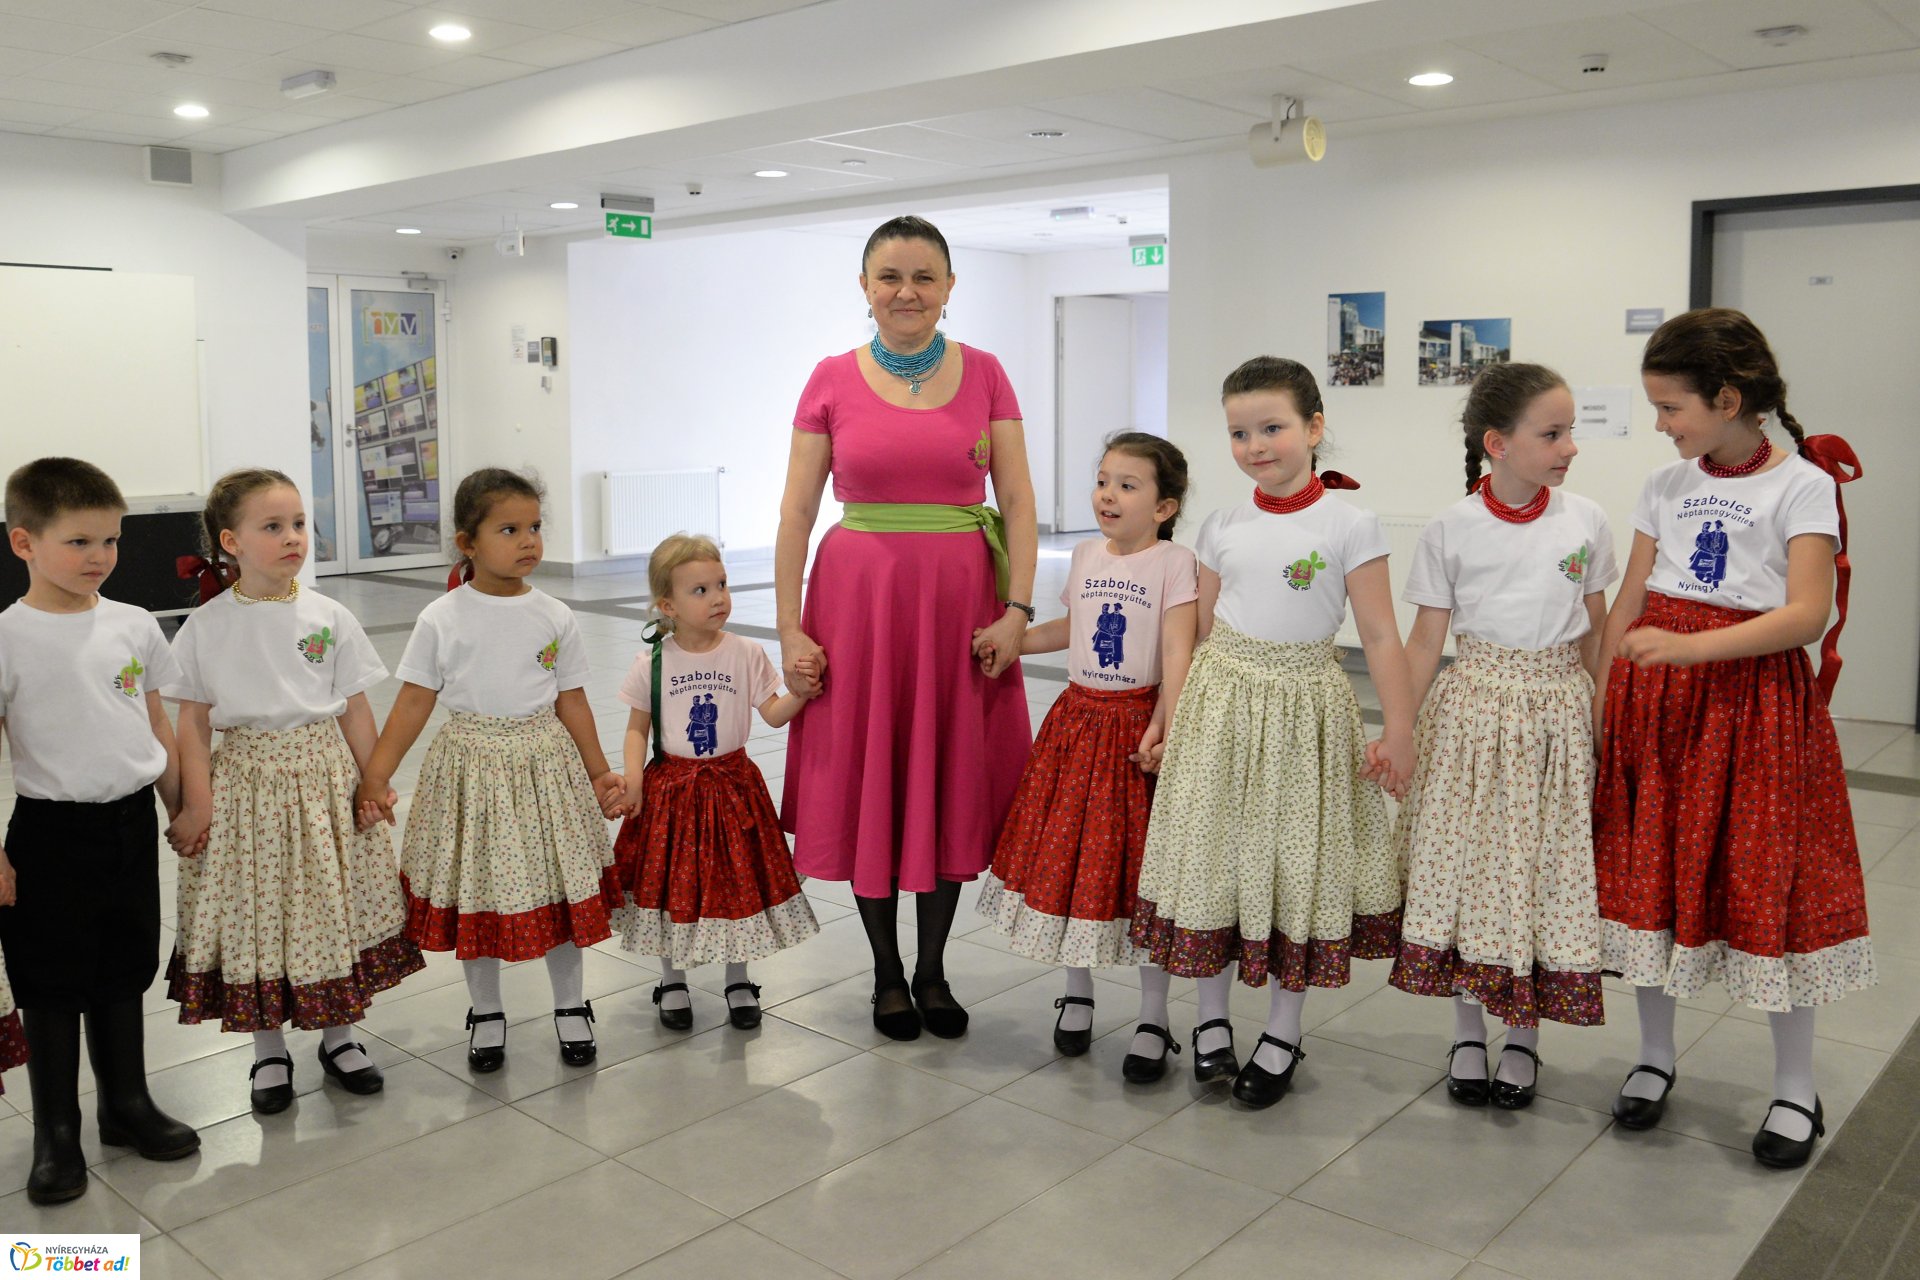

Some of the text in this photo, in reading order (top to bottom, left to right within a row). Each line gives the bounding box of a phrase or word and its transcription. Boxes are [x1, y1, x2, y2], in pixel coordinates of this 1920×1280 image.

[1683, 495, 1752, 515] Szabolcs
[1677, 508, 1755, 527] Néptáncegyüttes
[1085, 577, 1147, 595] Szabolcs
[1081, 590, 1152, 609] Néptáncegyüttes
[671, 670, 732, 686] Szabolcs
[1082, 669, 1136, 684] Nyíregyháza
[669, 683, 737, 697] Néptáncegyüttes
